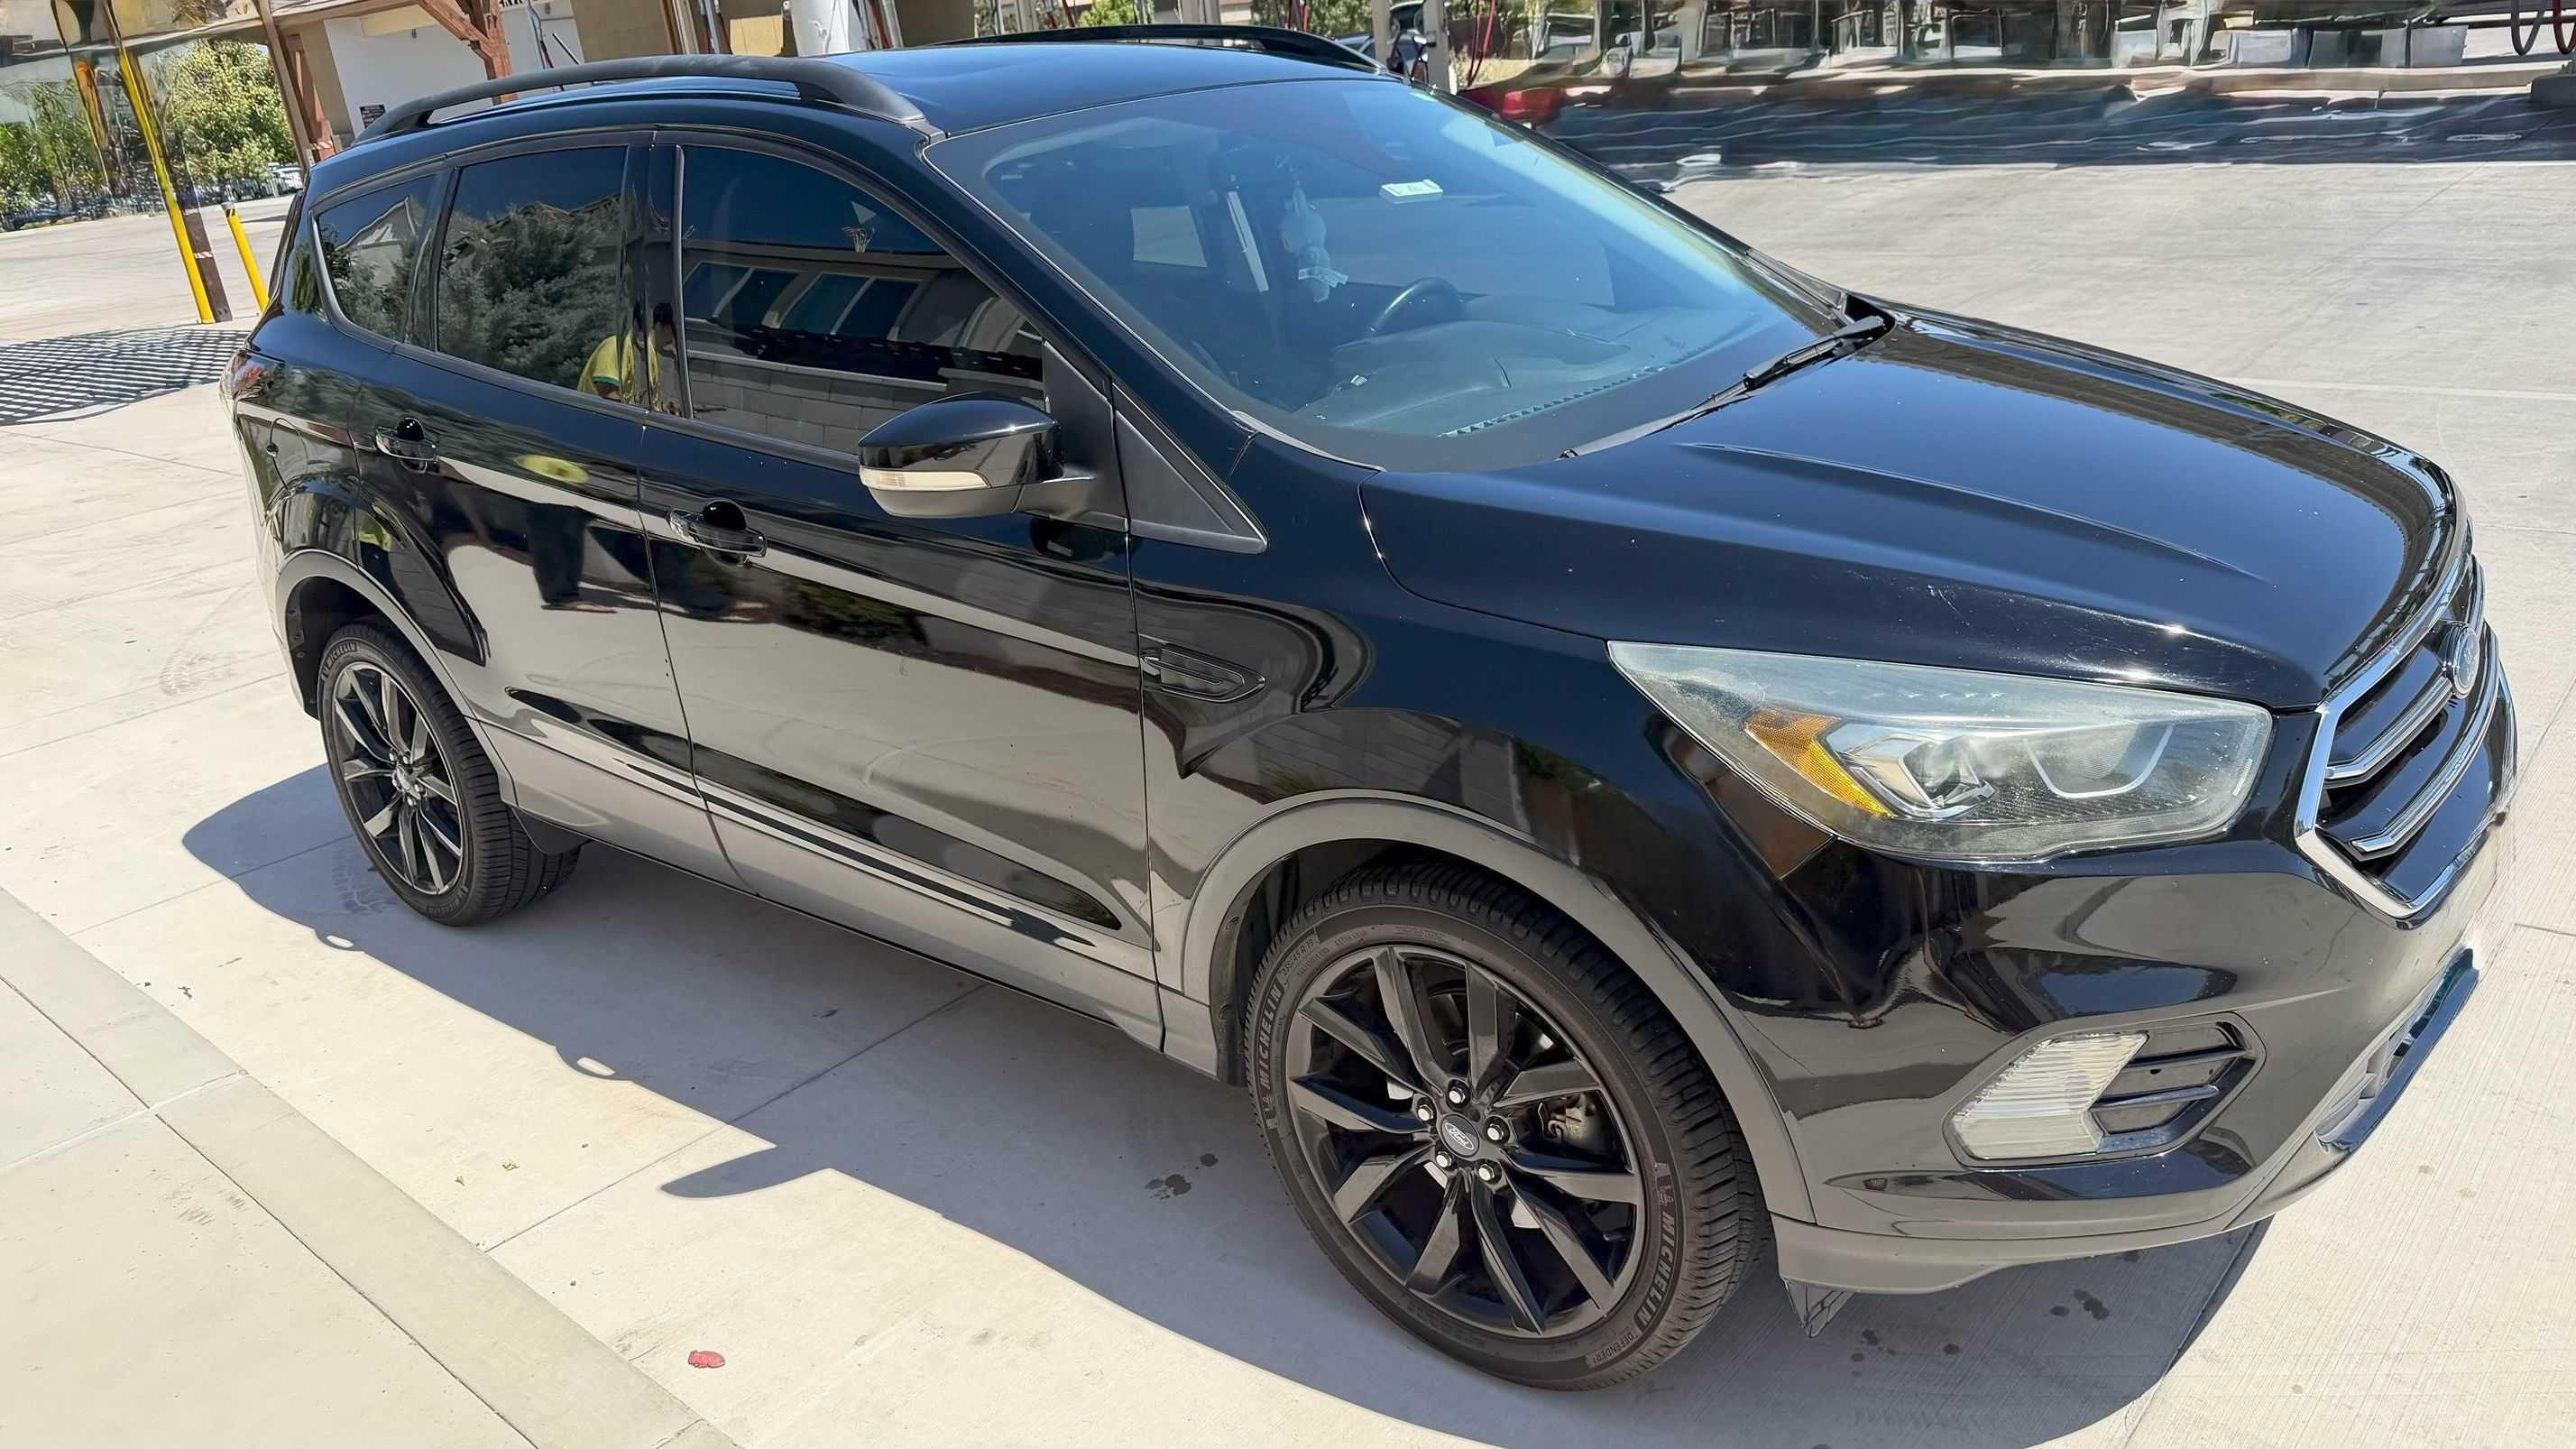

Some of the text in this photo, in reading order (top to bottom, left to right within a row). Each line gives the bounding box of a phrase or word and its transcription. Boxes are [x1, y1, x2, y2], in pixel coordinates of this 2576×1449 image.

[1306, 938, 1314, 949] 19
[1258, 983, 1283, 1090] MICHELIN
[1637, 1211, 1676, 1326] MICHELIN
